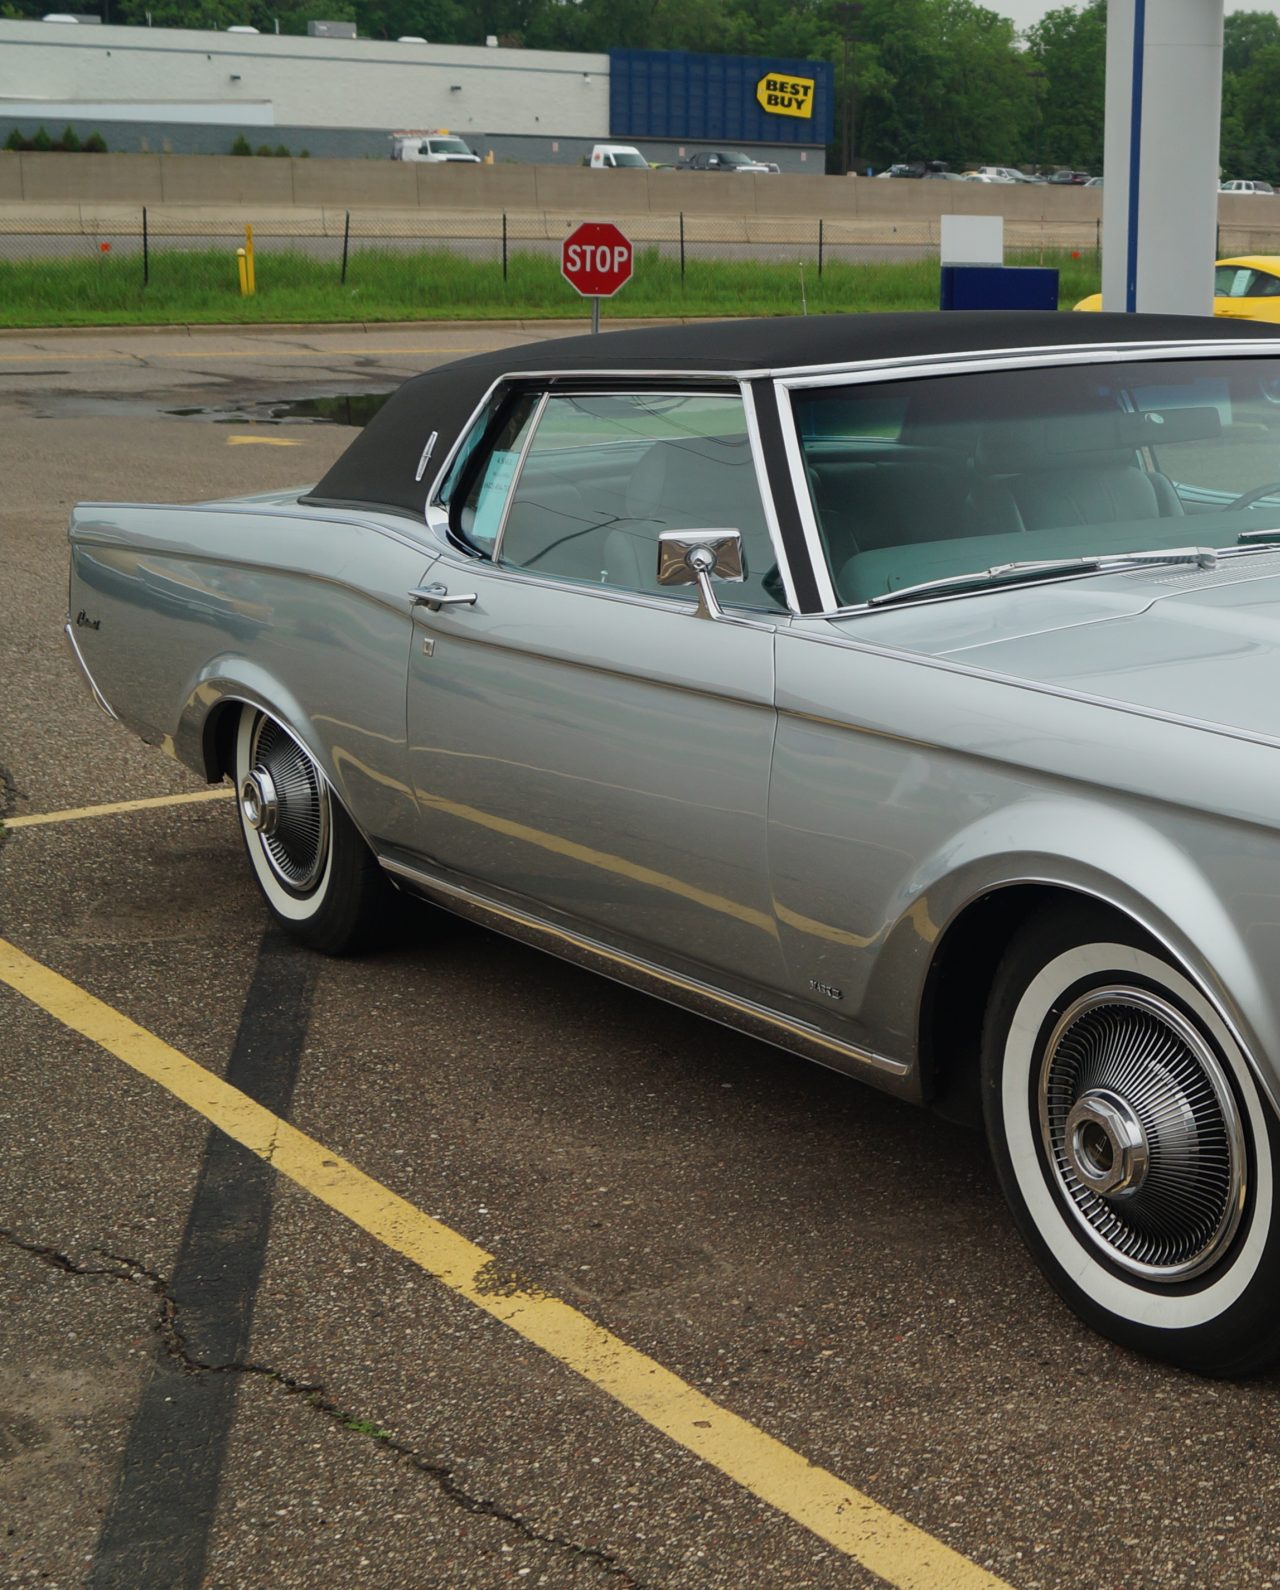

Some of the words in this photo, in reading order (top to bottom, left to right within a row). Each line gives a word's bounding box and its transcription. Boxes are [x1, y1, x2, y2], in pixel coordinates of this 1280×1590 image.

[766, 80, 811, 97] BEST
[767, 94, 807, 110] BUY
[566, 244, 629, 273] STOP
